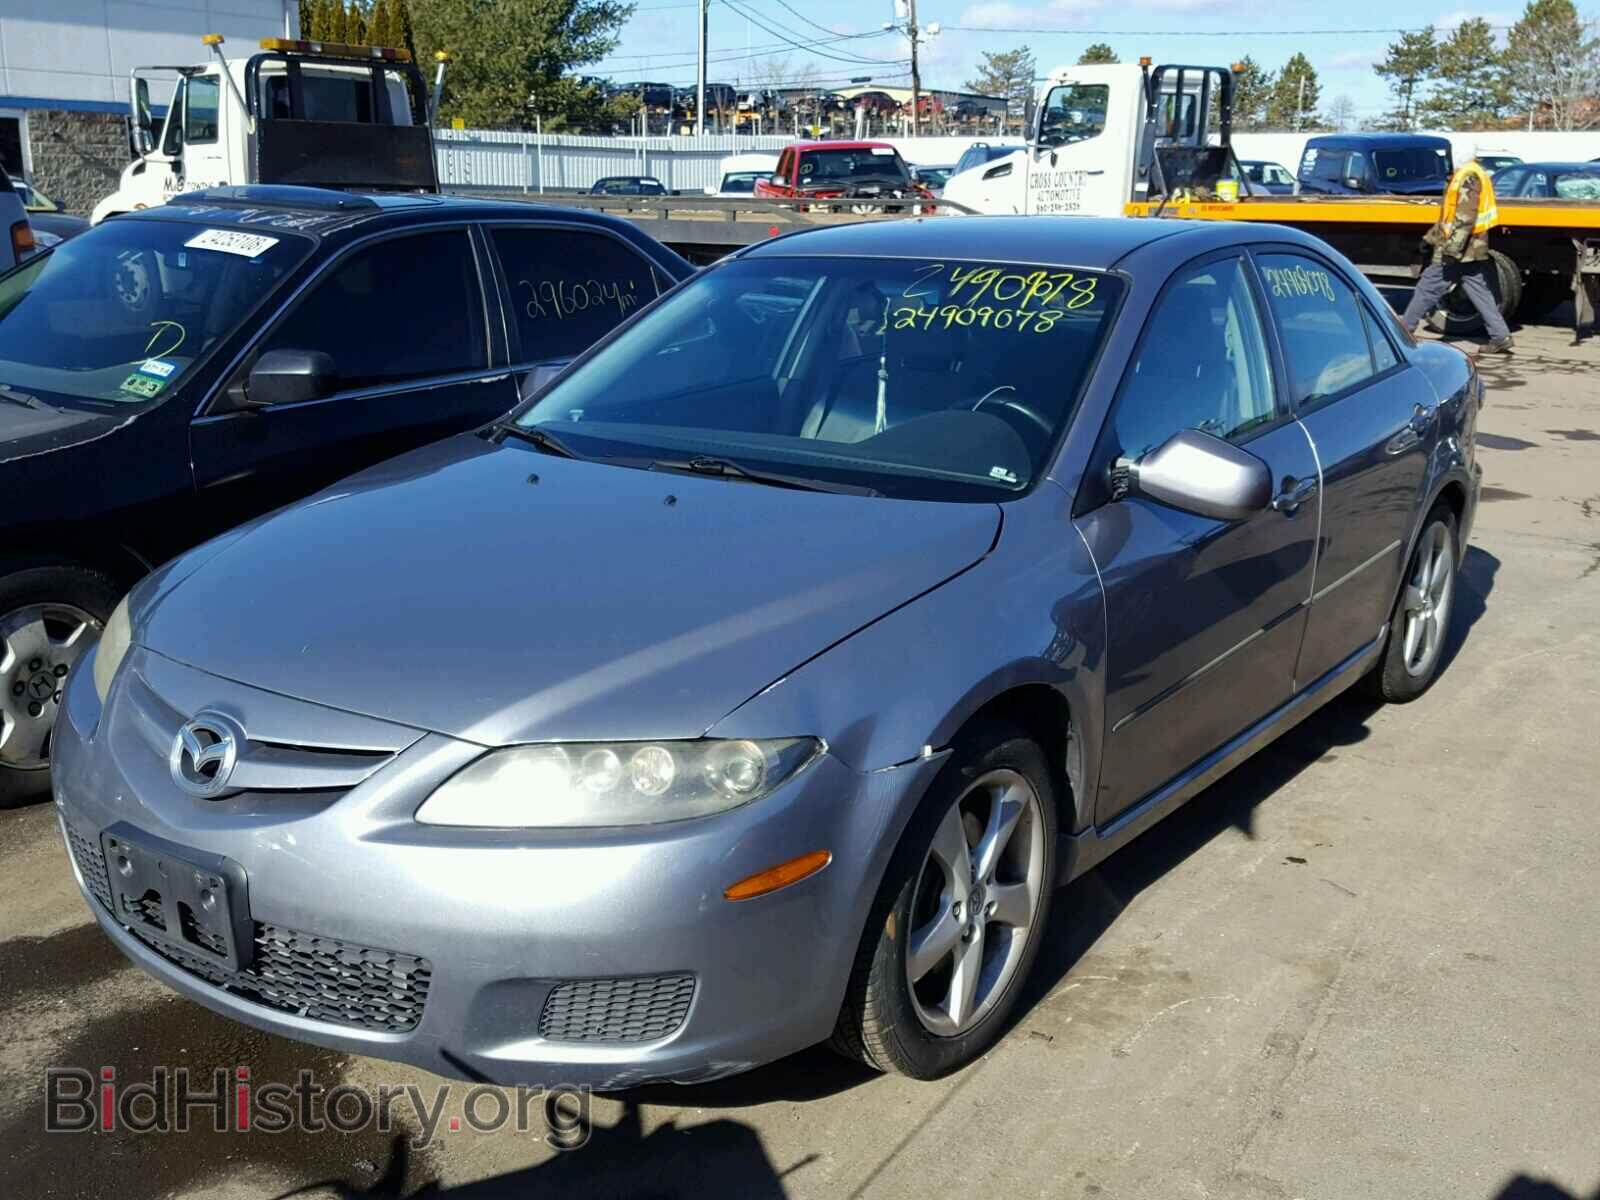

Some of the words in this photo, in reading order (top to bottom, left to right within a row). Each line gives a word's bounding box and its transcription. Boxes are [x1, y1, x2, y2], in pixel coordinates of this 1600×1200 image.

[1030, 172, 1052, 190] CROSS
[1037, 188, 1081, 202] AUTOMOTIVE
[892, 304, 1064, 333] 24909078
